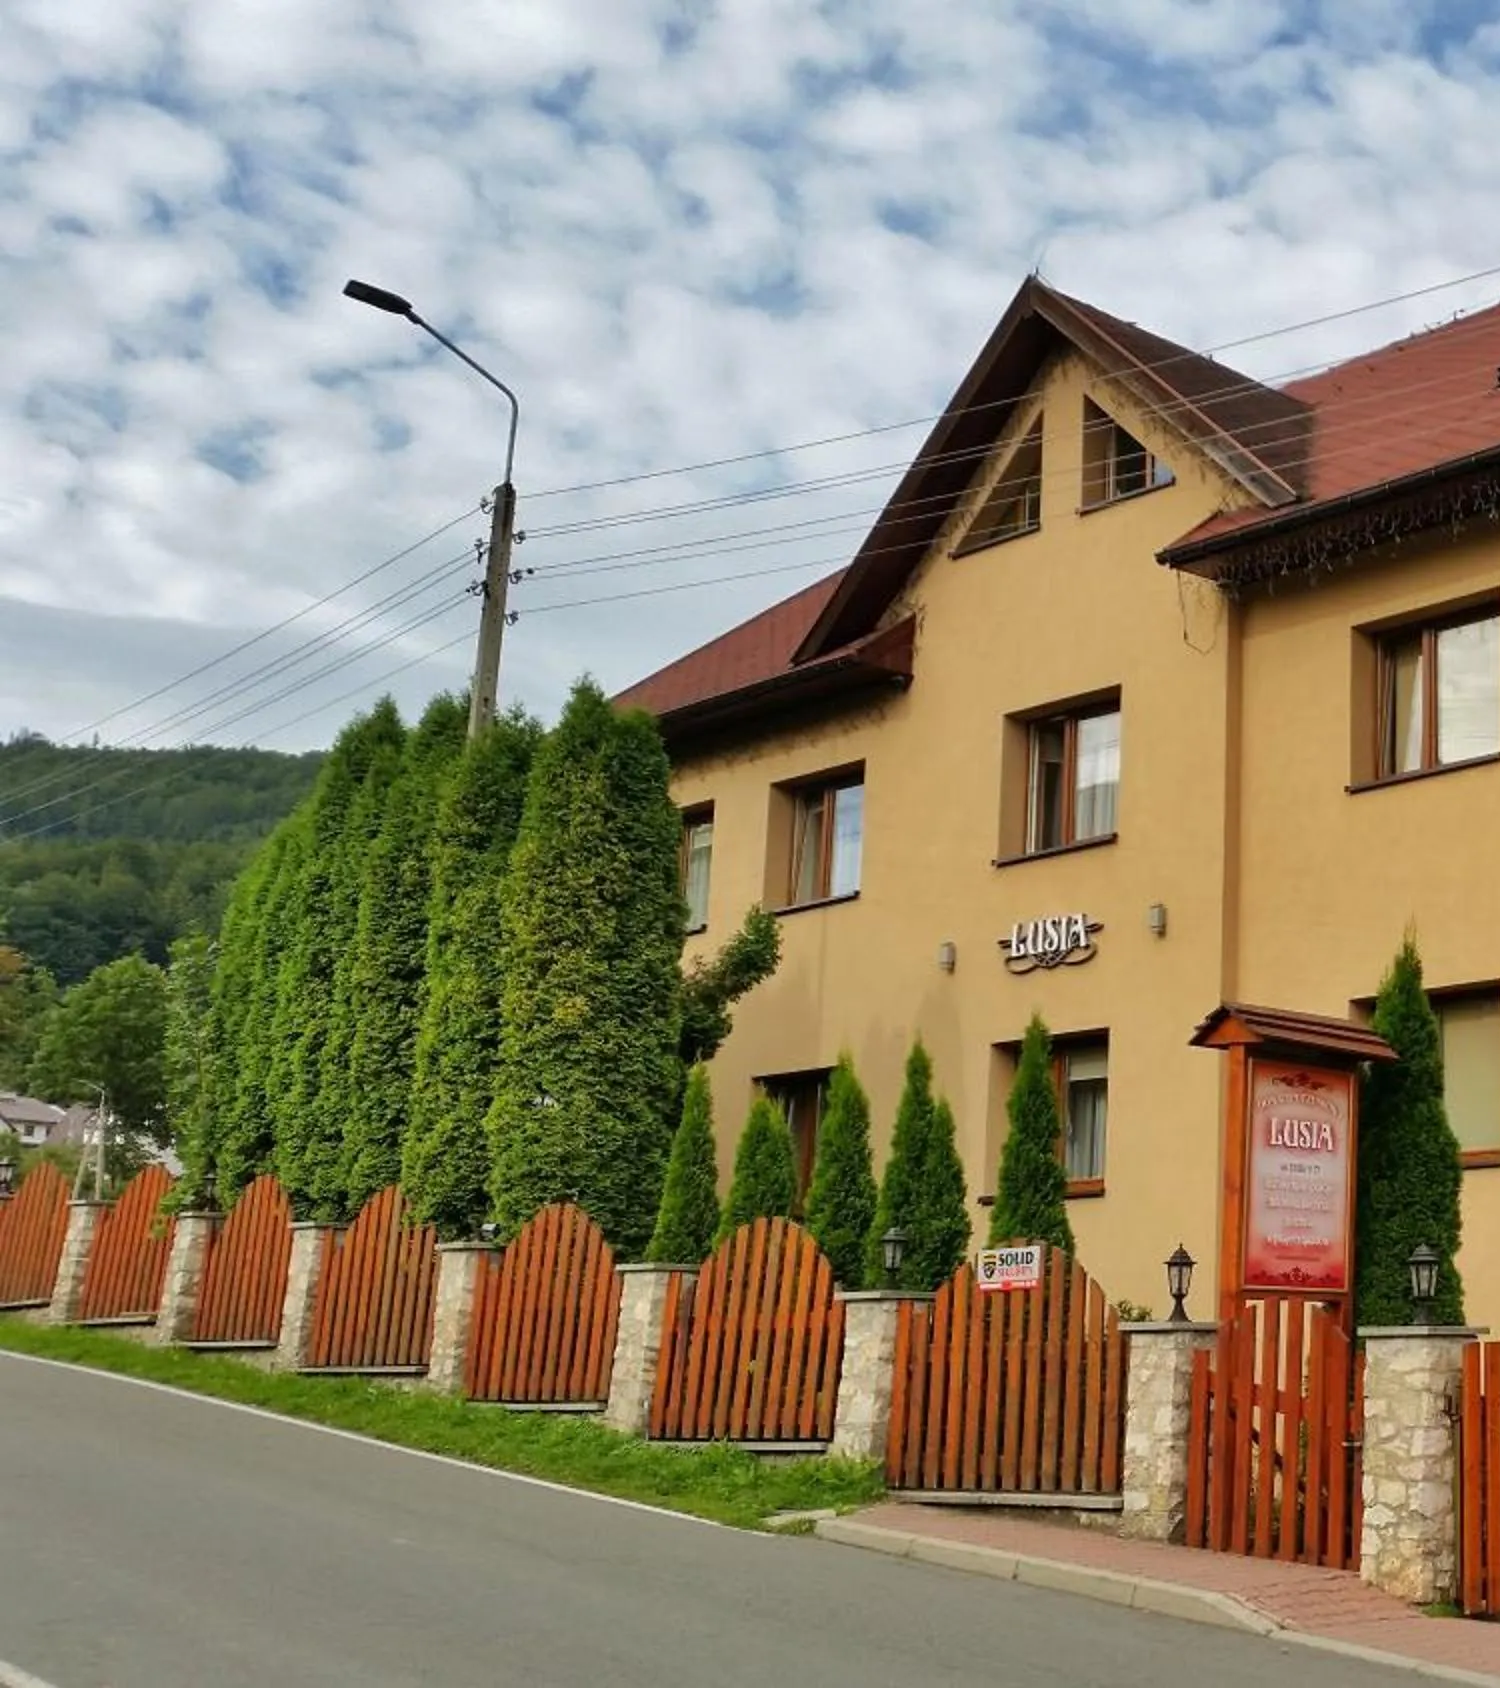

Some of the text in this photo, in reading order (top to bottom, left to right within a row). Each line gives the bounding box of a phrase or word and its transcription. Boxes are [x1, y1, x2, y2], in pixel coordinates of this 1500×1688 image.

[1010, 913, 1090, 957] LUSIA
[1268, 1116, 1334, 1151] LUSIA
[998, 1251, 1034, 1267] SOLID
